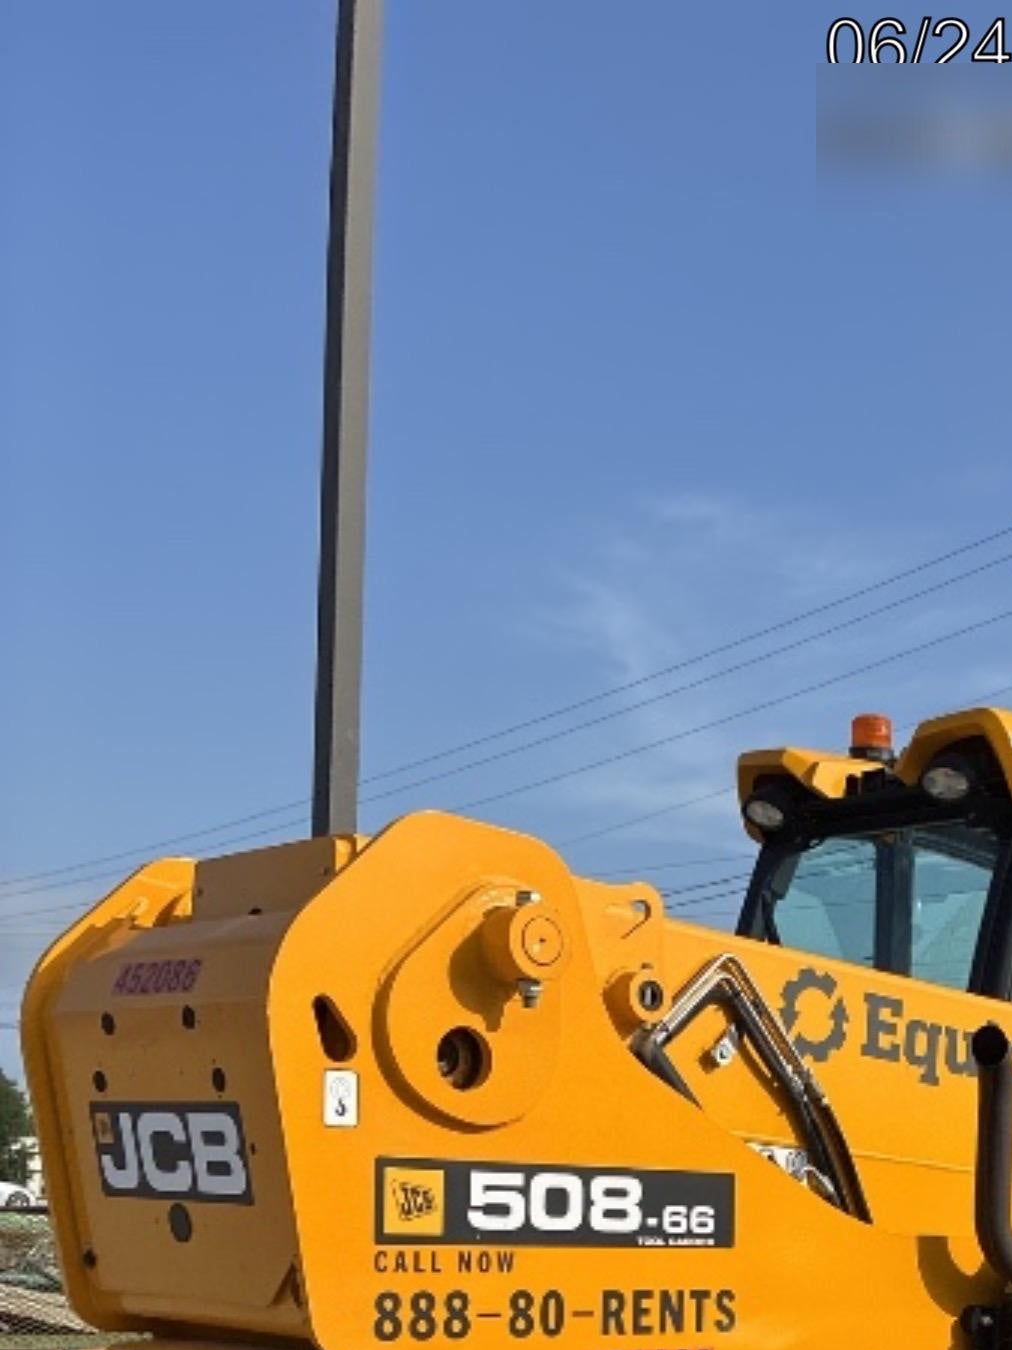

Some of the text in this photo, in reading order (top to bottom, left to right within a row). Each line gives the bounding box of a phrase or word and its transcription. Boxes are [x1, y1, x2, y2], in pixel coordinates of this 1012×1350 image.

[114, 960, 202, 994] 452086
[101, 1112, 247, 1196] JCB
[374, 1251, 515, 1273] CALL NOW
[374, 1289, 736, 1341] 888-80-RENTS
